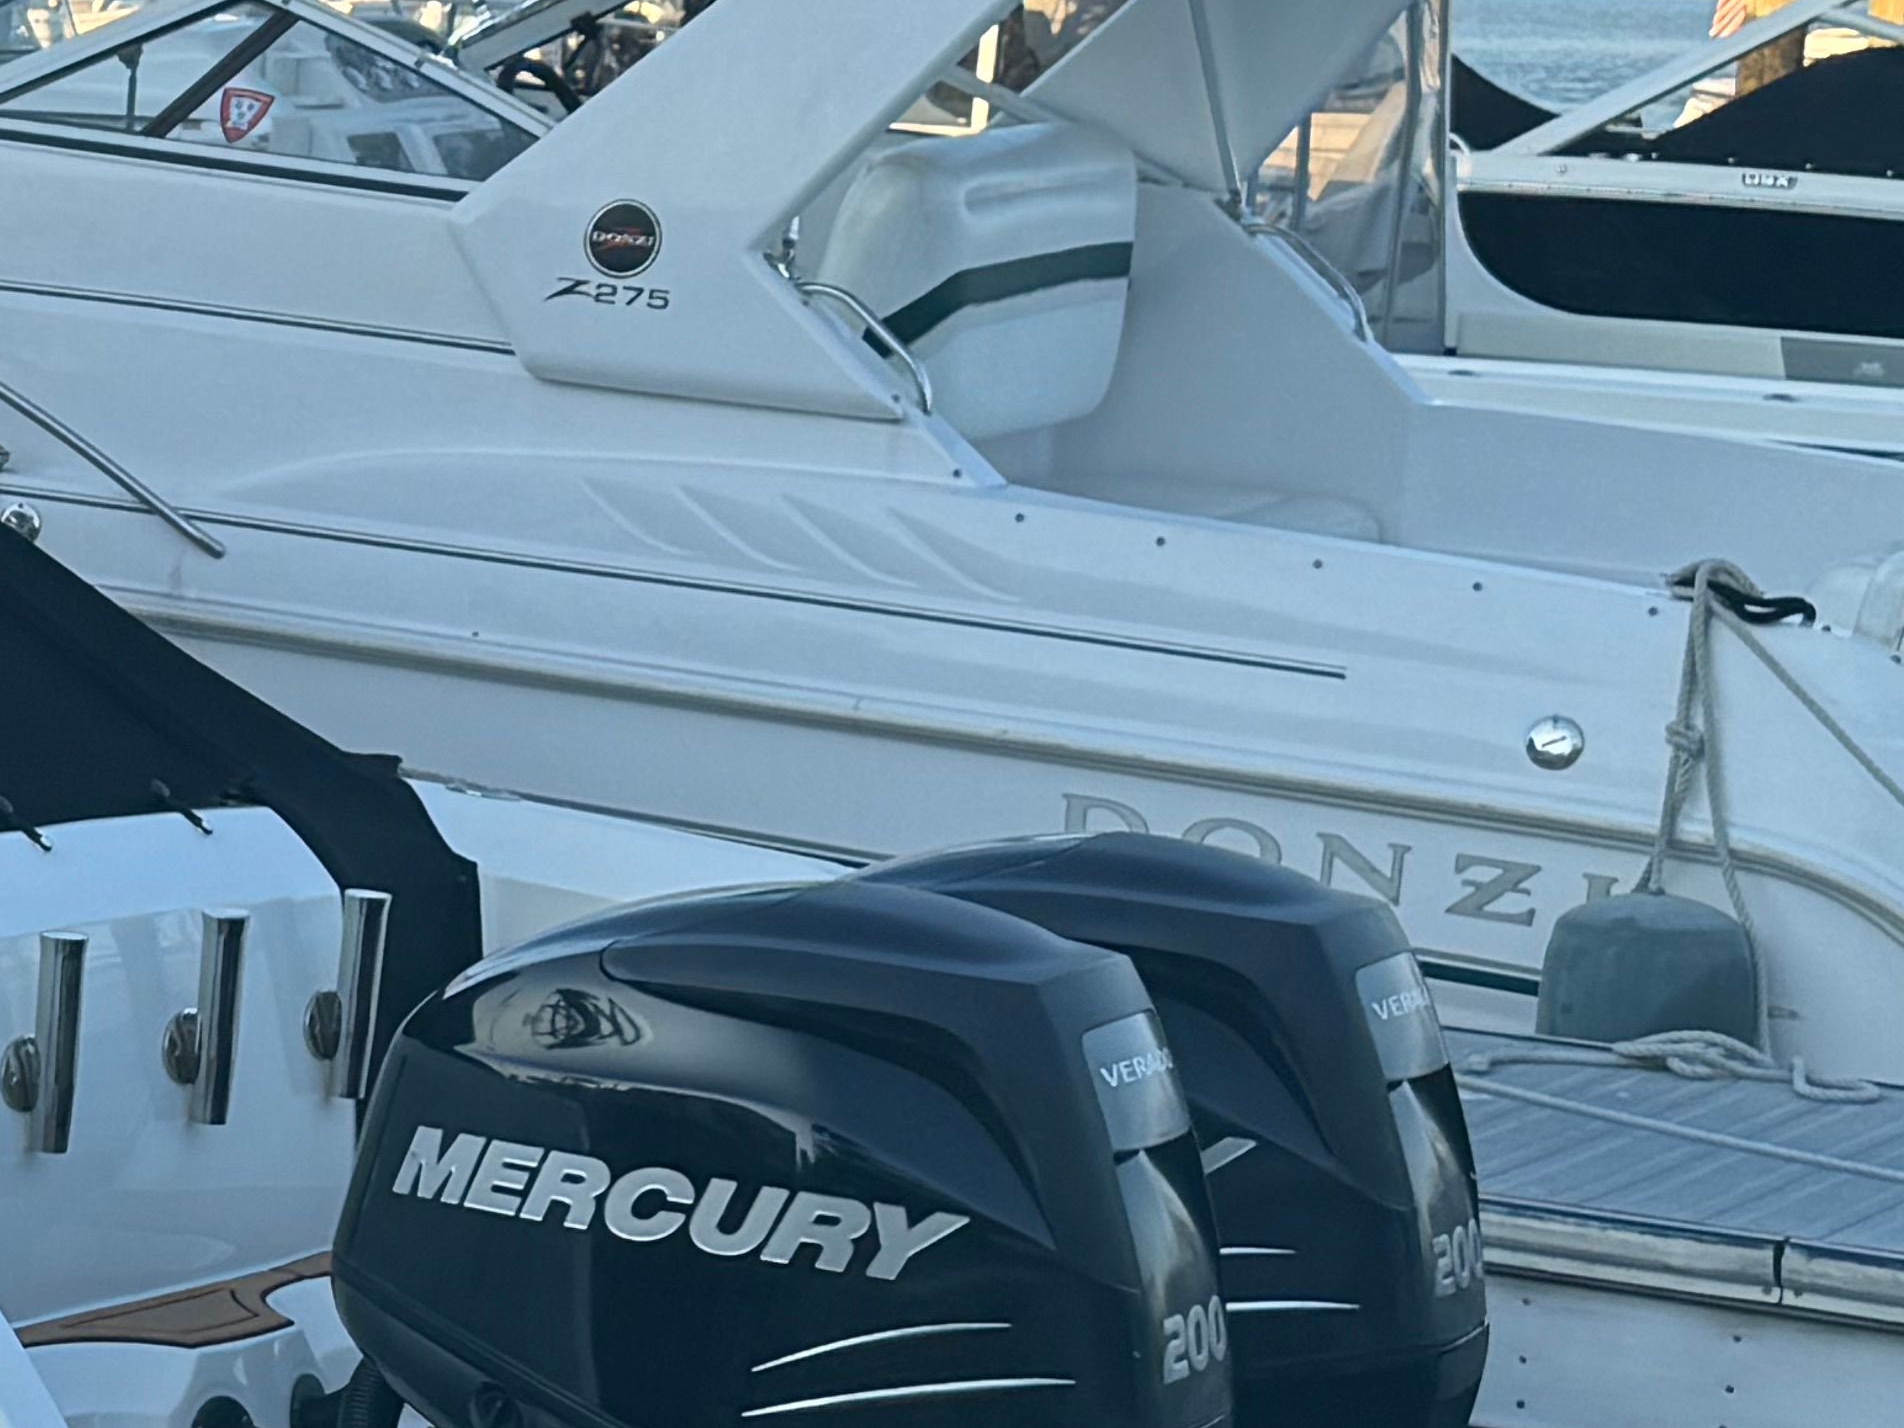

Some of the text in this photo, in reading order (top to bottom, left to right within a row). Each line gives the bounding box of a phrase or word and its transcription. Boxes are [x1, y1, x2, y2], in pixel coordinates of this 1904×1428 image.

[544, 276, 671, 310] Z275
[391, 1125, 971, 1281] MERCURY
[1431, 1217, 1484, 1298] 200
[1163, 1294, 1227, 1385] 200
